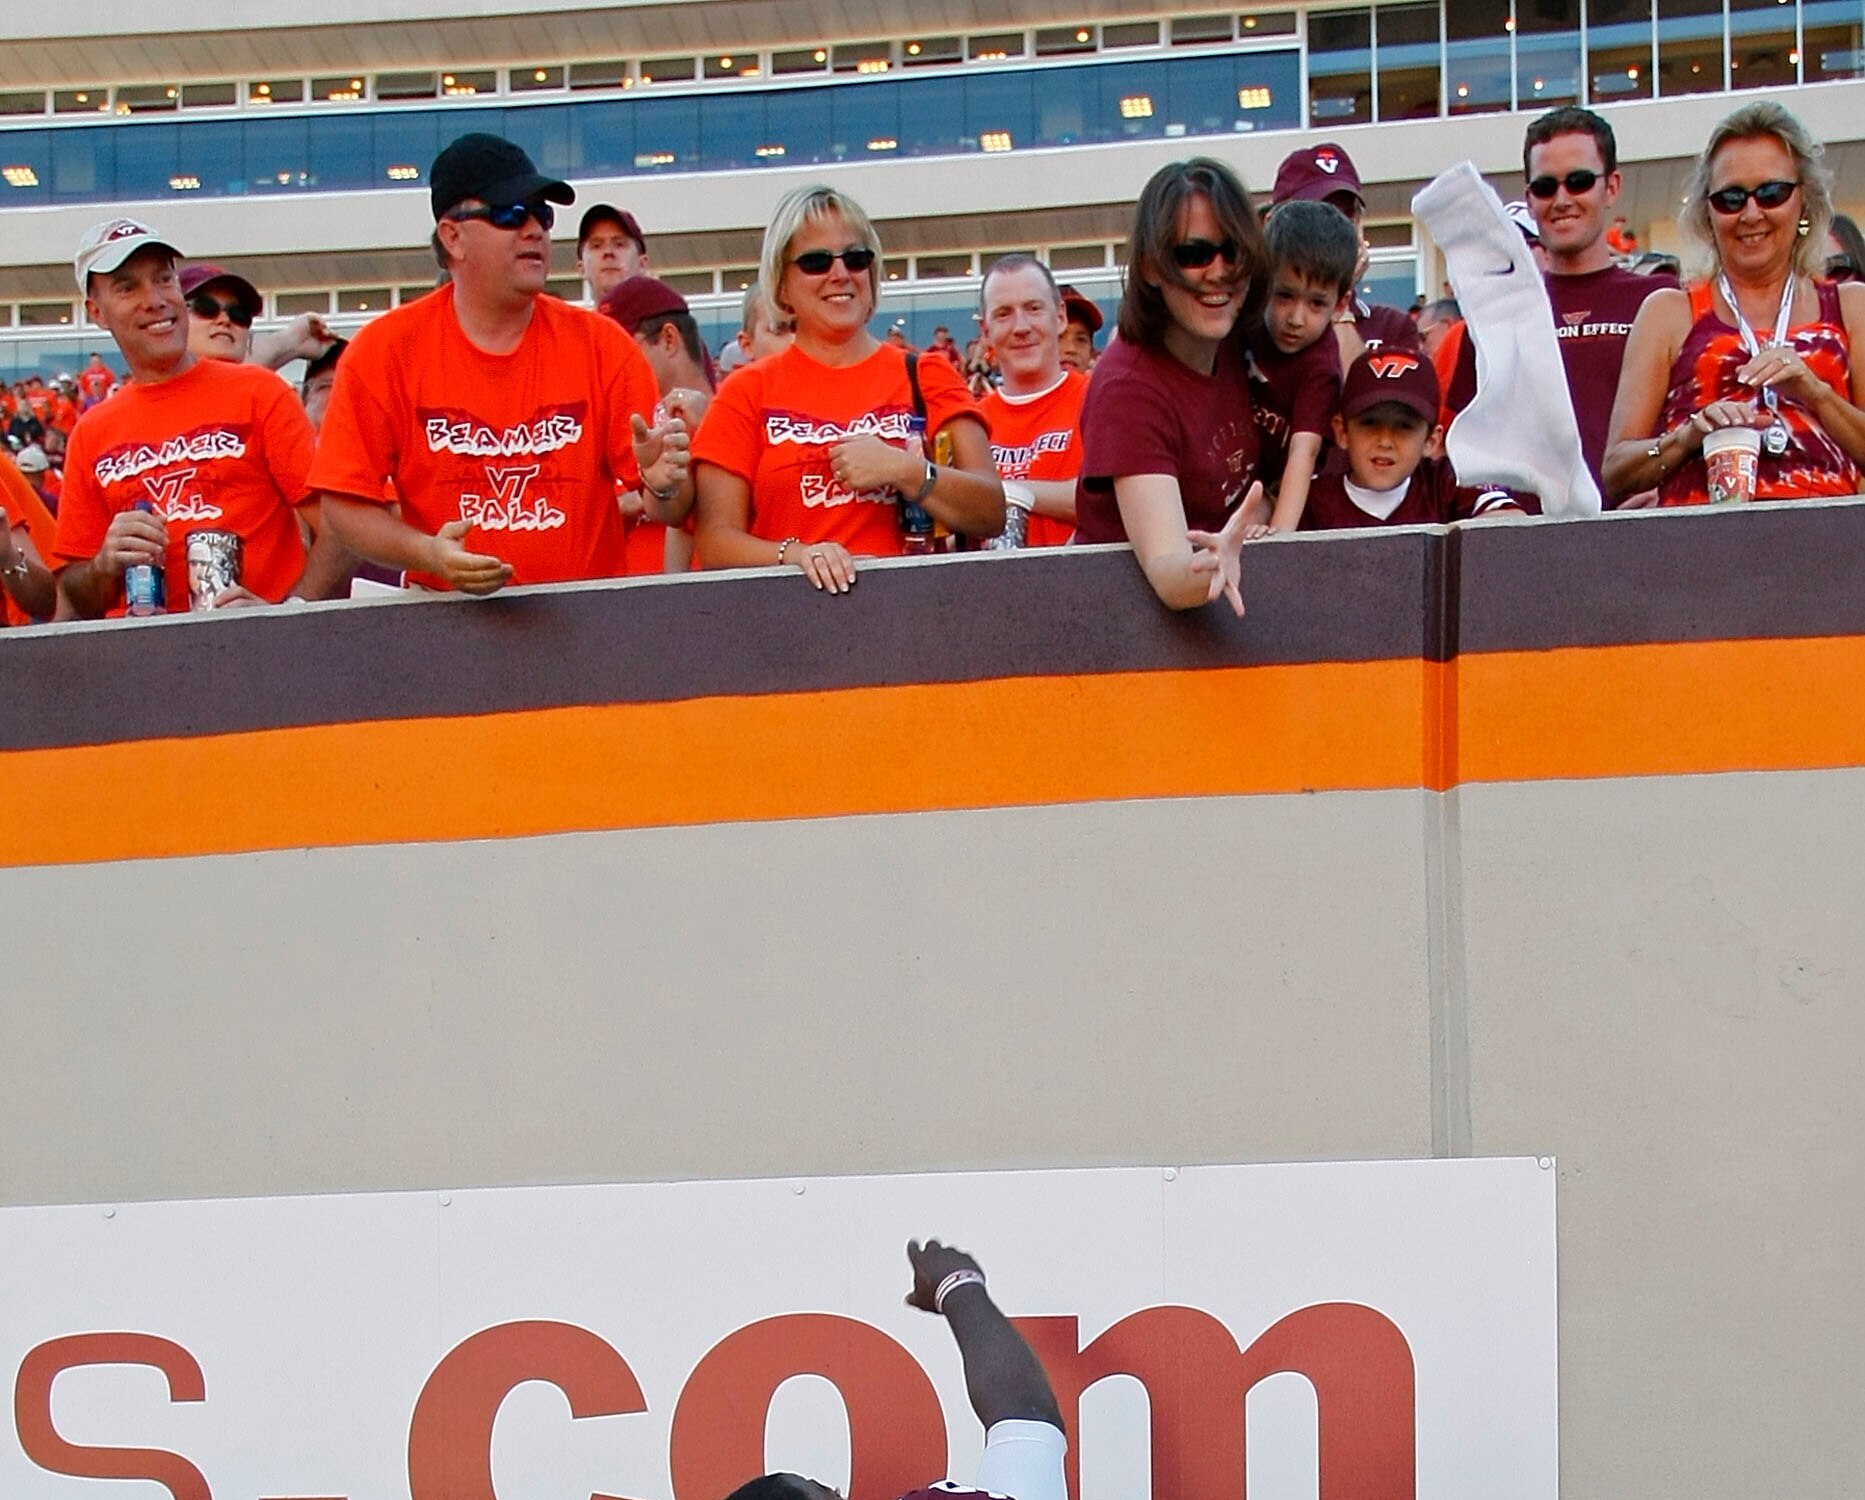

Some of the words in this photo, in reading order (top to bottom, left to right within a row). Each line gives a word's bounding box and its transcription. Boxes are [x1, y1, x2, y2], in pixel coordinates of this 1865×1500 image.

[117, 225, 136, 235] VT
[1367, 352, 1419, 378] VT
[425, 415, 582, 457] BEAMER
[95, 431, 246, 487] BEAMER
[143, 467, 197, 500] VT
[485, 464, 540, 502] VT
[459, 492, 566, 532] BALL
